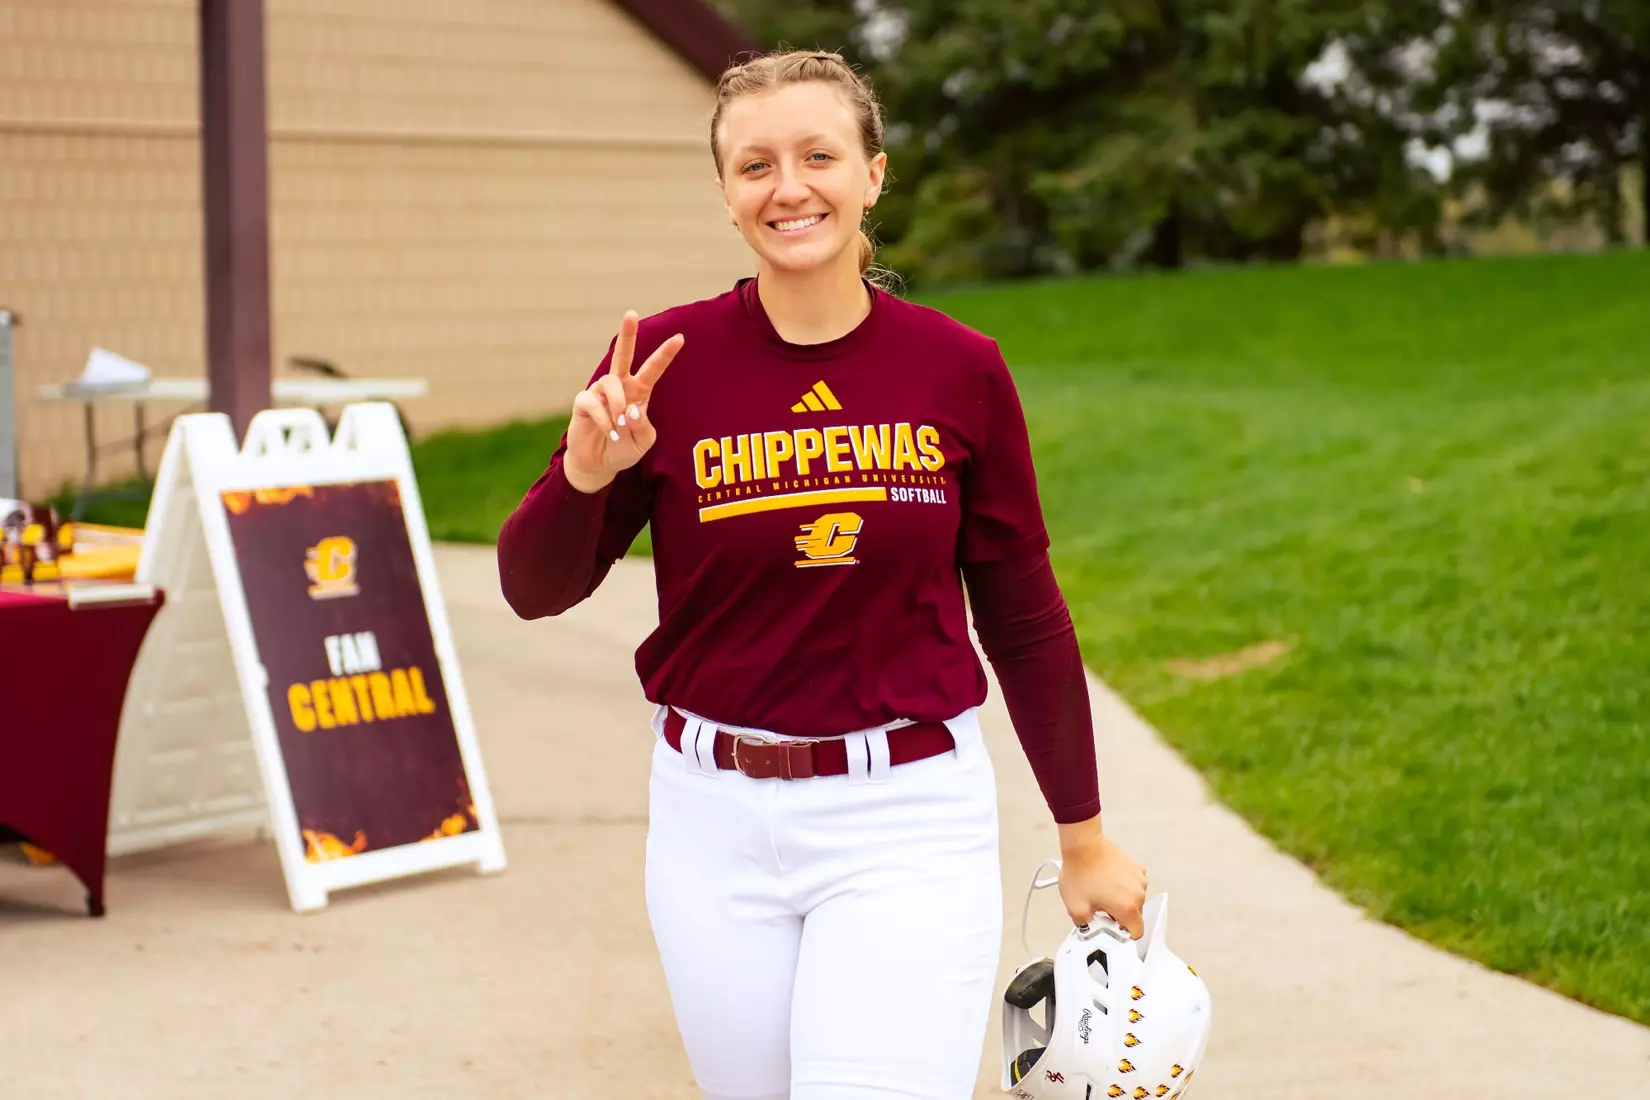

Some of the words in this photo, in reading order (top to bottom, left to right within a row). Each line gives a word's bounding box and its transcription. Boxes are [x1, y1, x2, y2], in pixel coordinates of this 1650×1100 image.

[693, 422, 945, 490] CHIPPEWAS
[698, 484, 762, 504] CENTRAL
[772, 475, 851, 491] MICHIGAN
[861, 473, 946, 485] UNIVERSITY
[890, 486, 947, 505] SOFTBALL
[324, 631, 382, 677] FAN
[287, 666, 435, 732] CENTRAL
[1077, 1007, 1093, 1045] Rawlings
